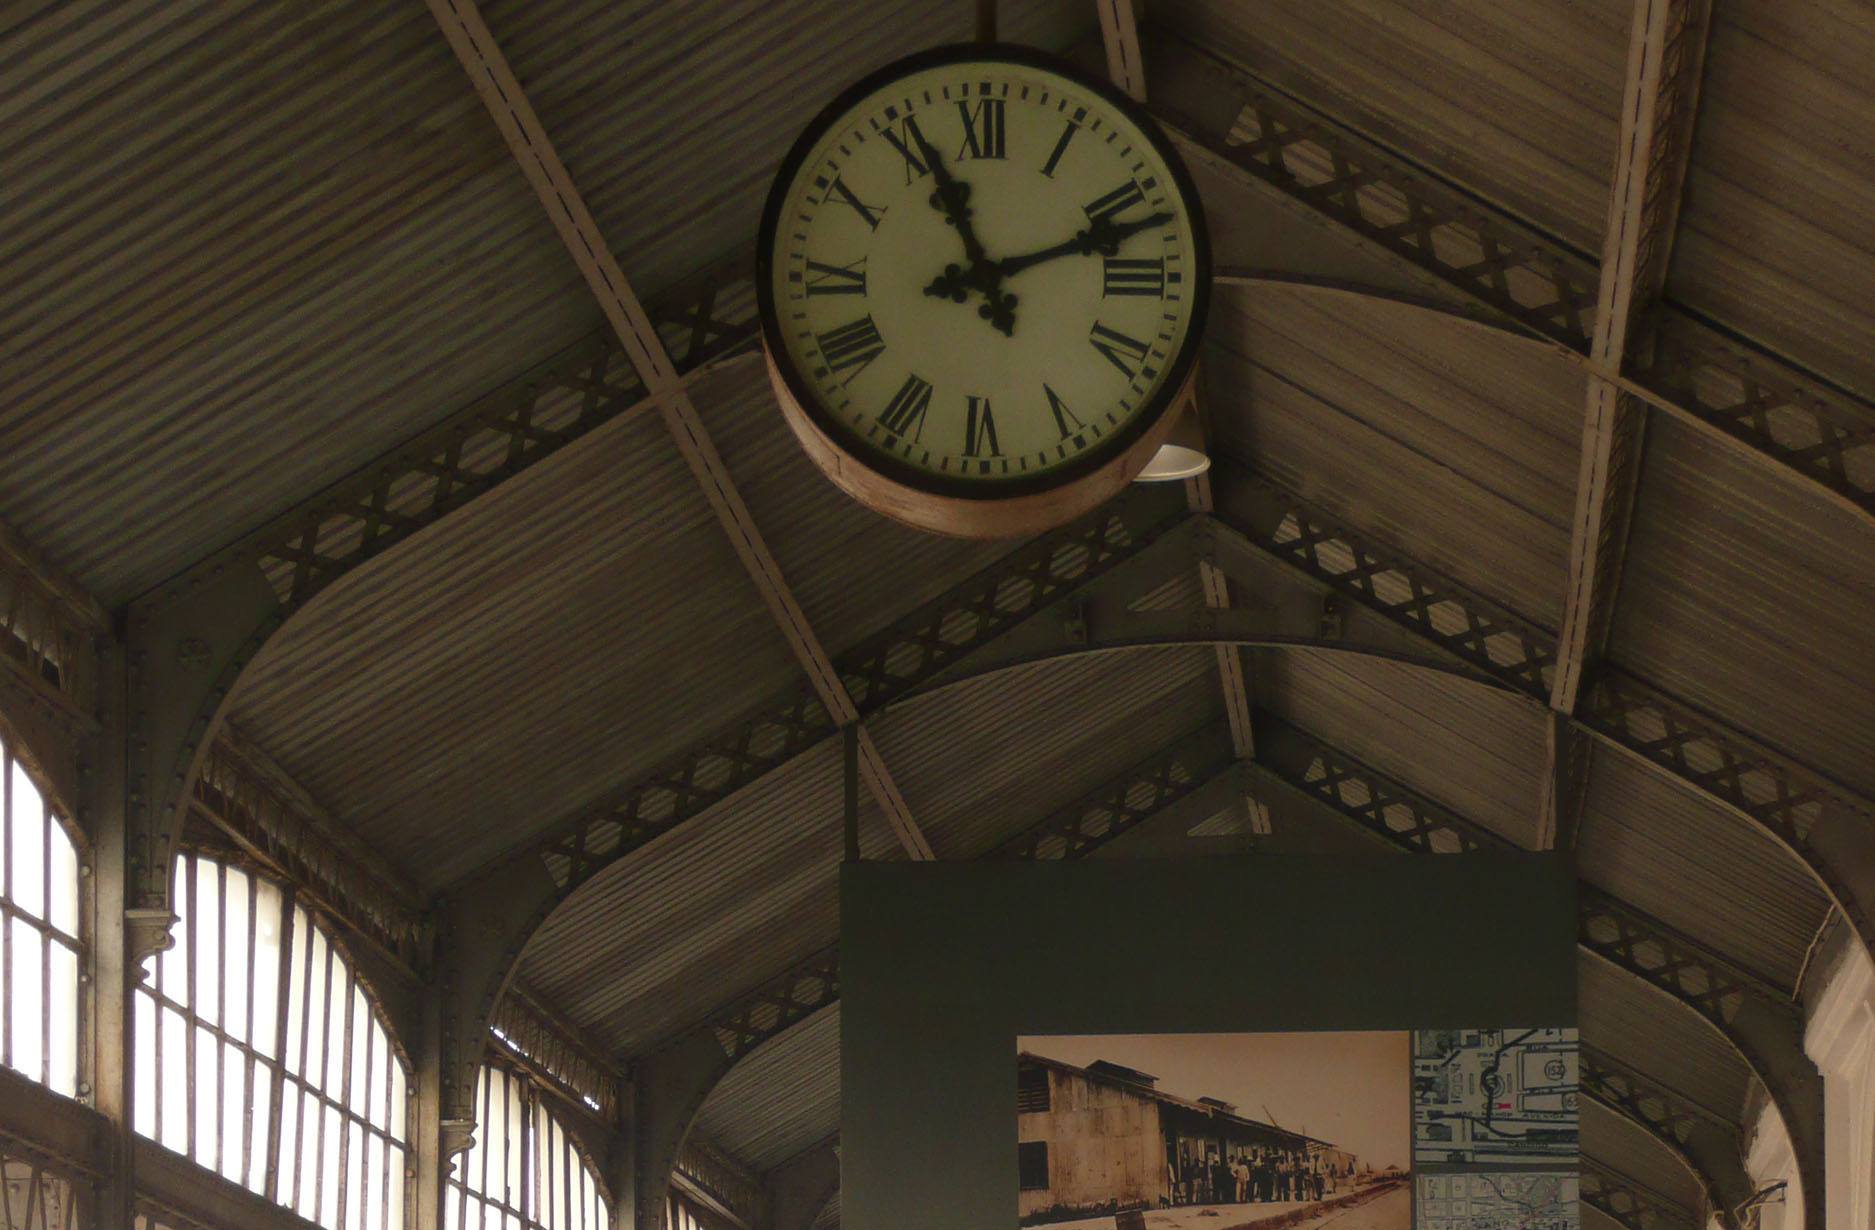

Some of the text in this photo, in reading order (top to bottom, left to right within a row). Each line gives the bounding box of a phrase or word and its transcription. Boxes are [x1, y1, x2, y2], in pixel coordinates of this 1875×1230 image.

[954, 98, 1008, 162] XII
[822, 174, 888, 231] X
[805, 255, 868, 299] IX
[1102, 256, 1165, 299] III
[814, 313, 887, 389] VIII
[1089, 320, 1152, 382] IV
[875, 372, 933, 444] VII
[961, 395, 1004, 458] VI
[1043, 382, 1088, 441] V
